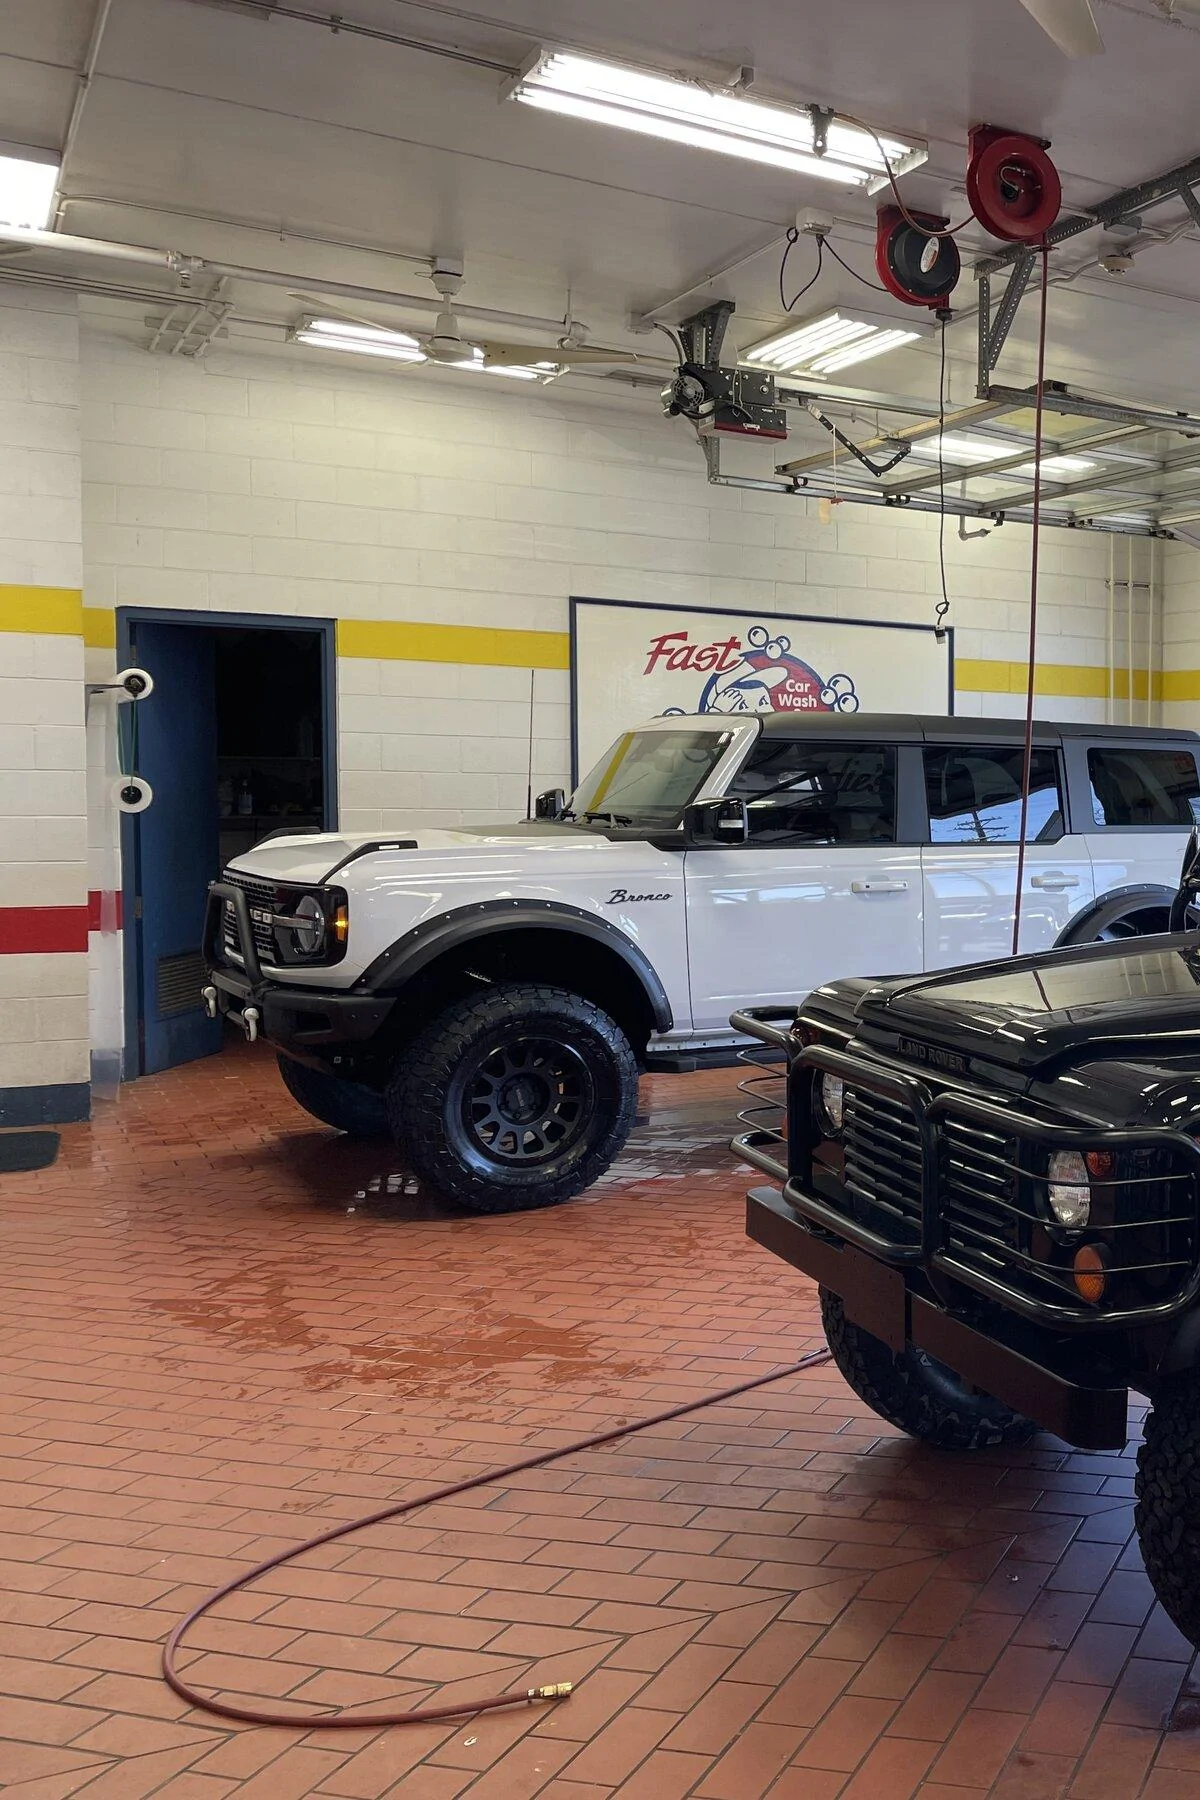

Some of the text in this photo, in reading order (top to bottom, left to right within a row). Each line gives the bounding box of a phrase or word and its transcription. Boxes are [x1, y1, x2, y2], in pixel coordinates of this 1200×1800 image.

[643, 631, 741, 675] Fast
[786, 680, 810, 692] Car
[778, 693, 817, 708] Wash
[605, 889, 673, 904] Bronco
[901, 1040, 968, 1073] LAND ROVER
